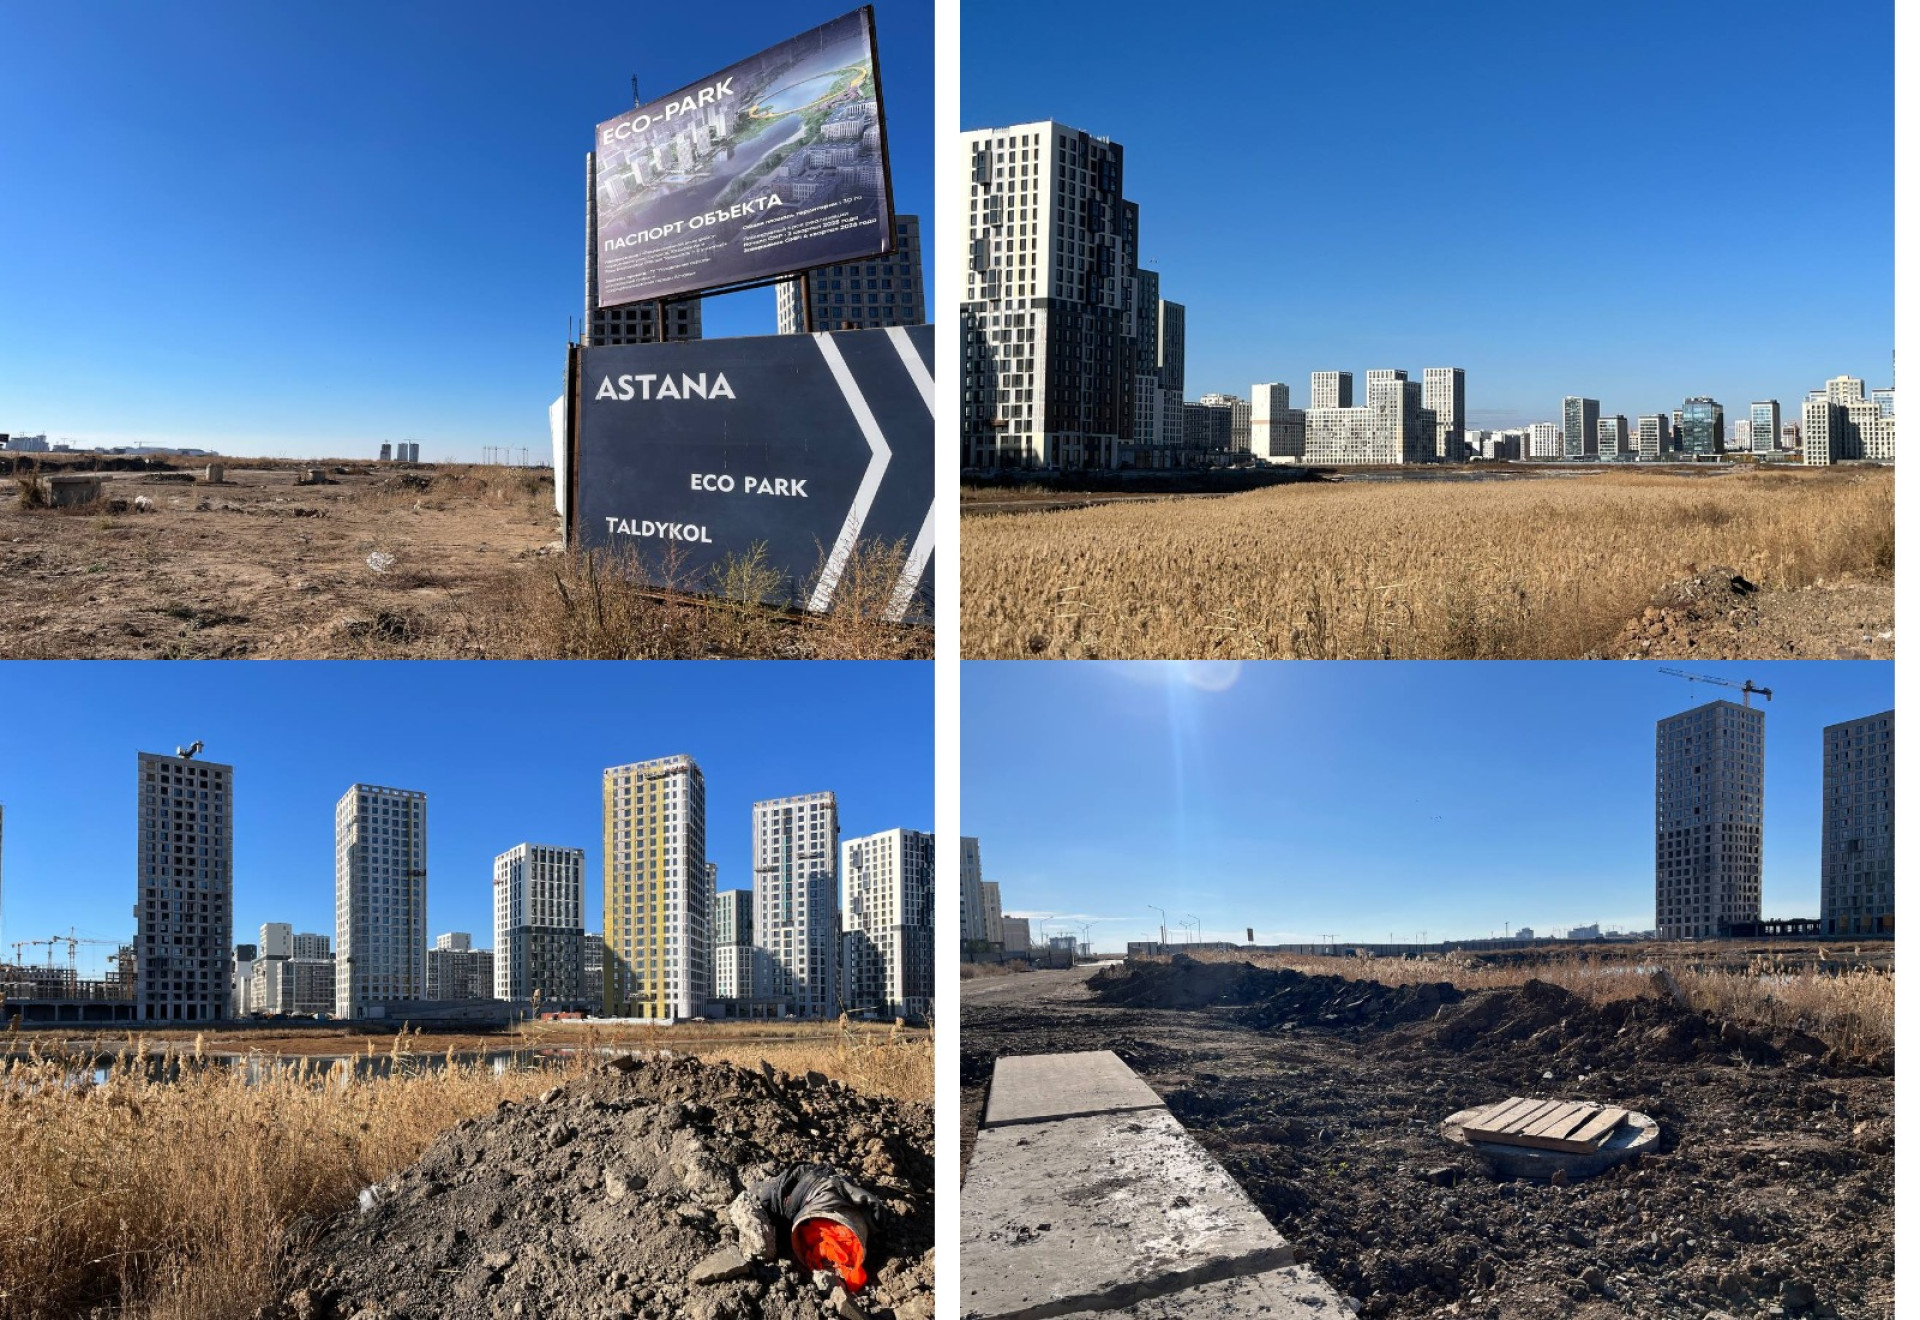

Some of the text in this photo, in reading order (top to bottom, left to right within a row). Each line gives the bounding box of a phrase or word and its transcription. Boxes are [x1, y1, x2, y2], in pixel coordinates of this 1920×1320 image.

[602, 76, 735, 146] ECO-PARK
[604, 220, 685, 252] ПАСПОРТ
[688, 193, 783, 229] ОБЪЕКТА
[595, 372, 736, 400] ASTANA
[691, 474, 808, 498] ECO PARK
[605, 516, 712, 543] TALDYKOL
